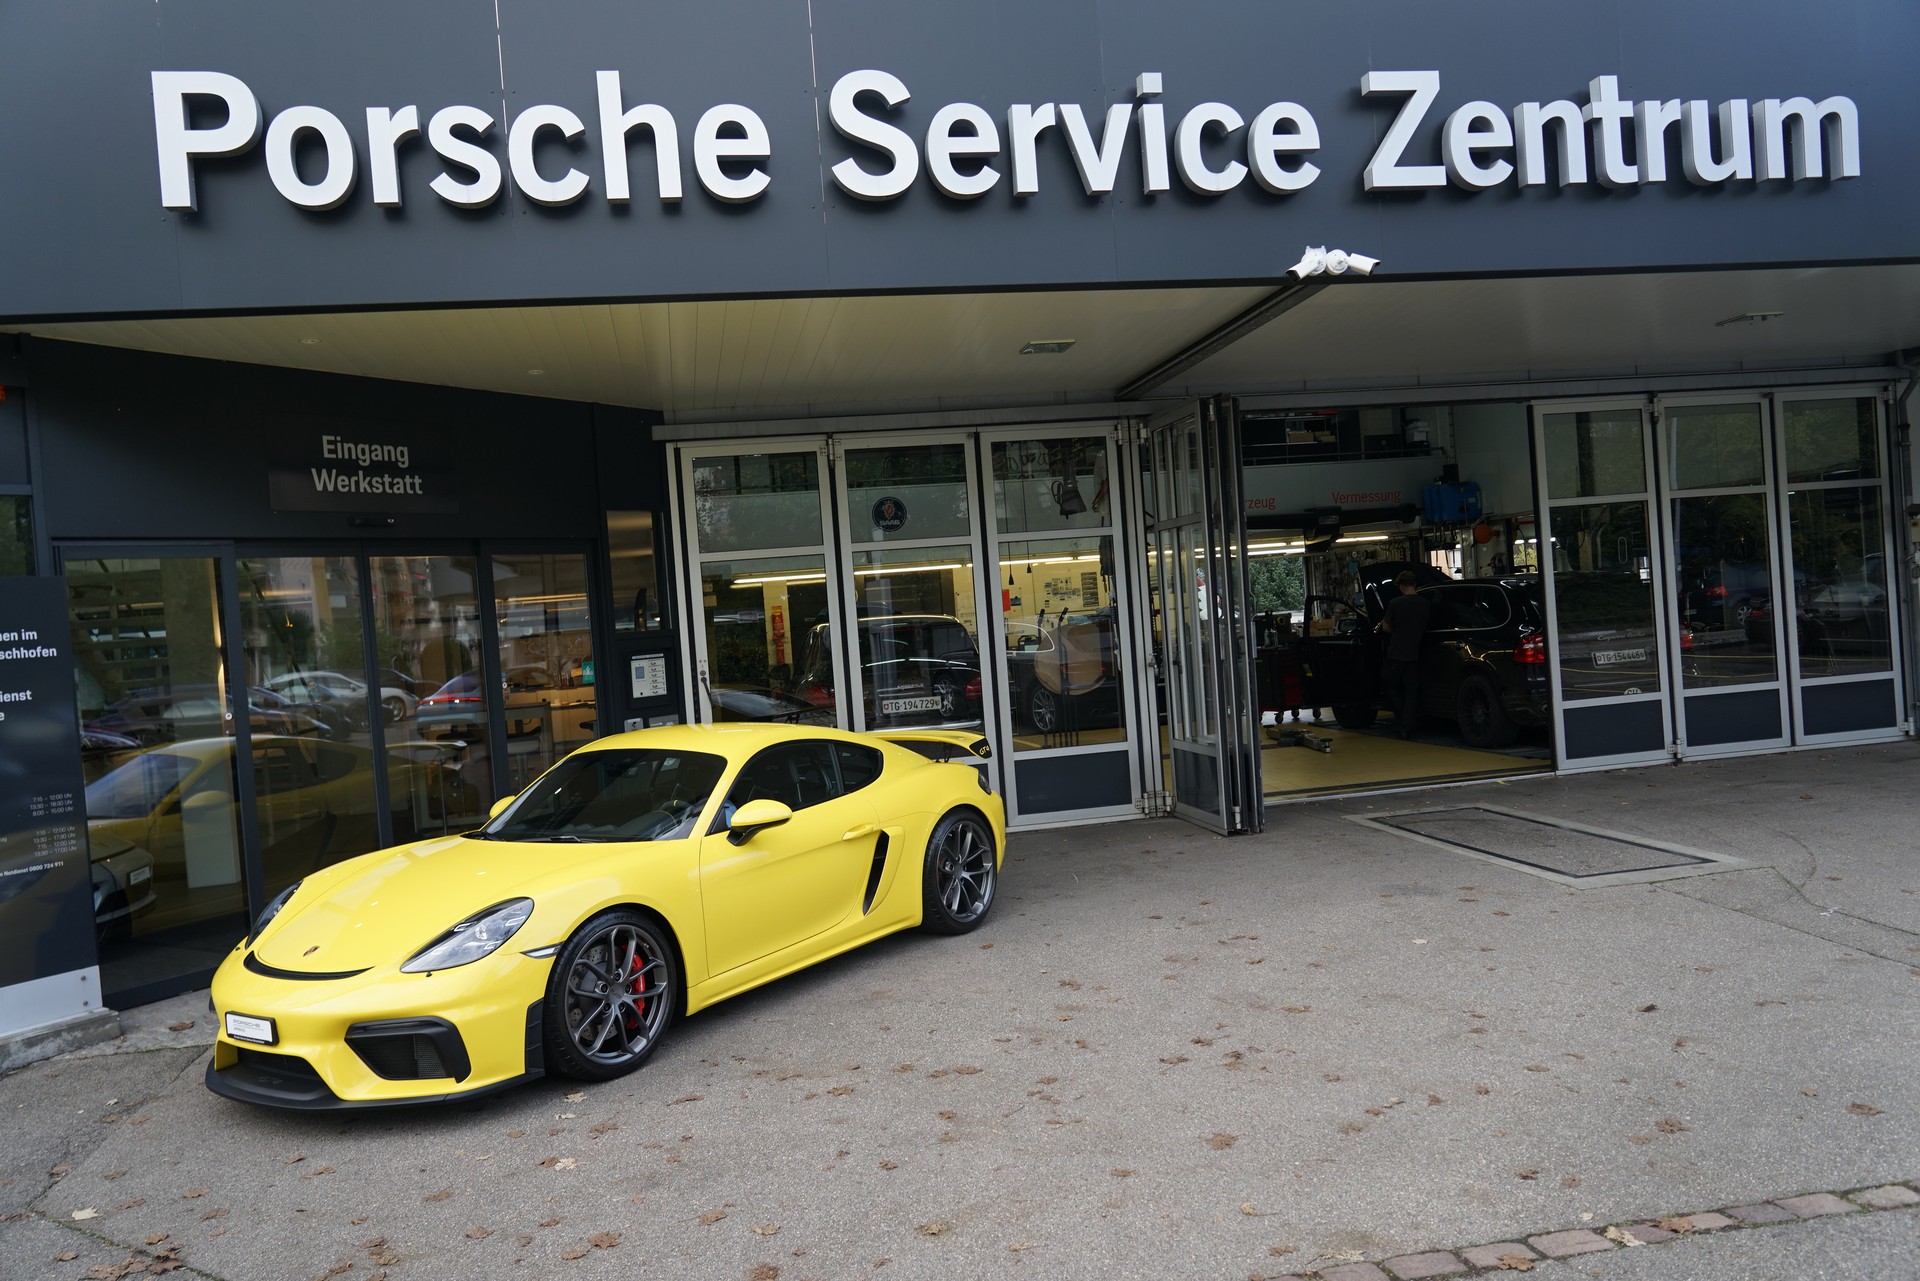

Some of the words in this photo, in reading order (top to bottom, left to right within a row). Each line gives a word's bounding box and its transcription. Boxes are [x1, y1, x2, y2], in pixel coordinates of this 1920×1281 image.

[151, 70, 772, 207] Porsche
[829, 69, 1321, 197] Service
[1365, 70, 1860, 187] Zentrum
[322, 435, 409, 468] Eingang
[311, 468, 423, 494] Werkstatt
[1245, 497, 1276, 510] zeug
[1332, 491, 1401, 504] Vermessung
[21, 629, 38, 640] im
[979, 745, 990, 755] GT4
[29, 864, 43, 872] 0800
